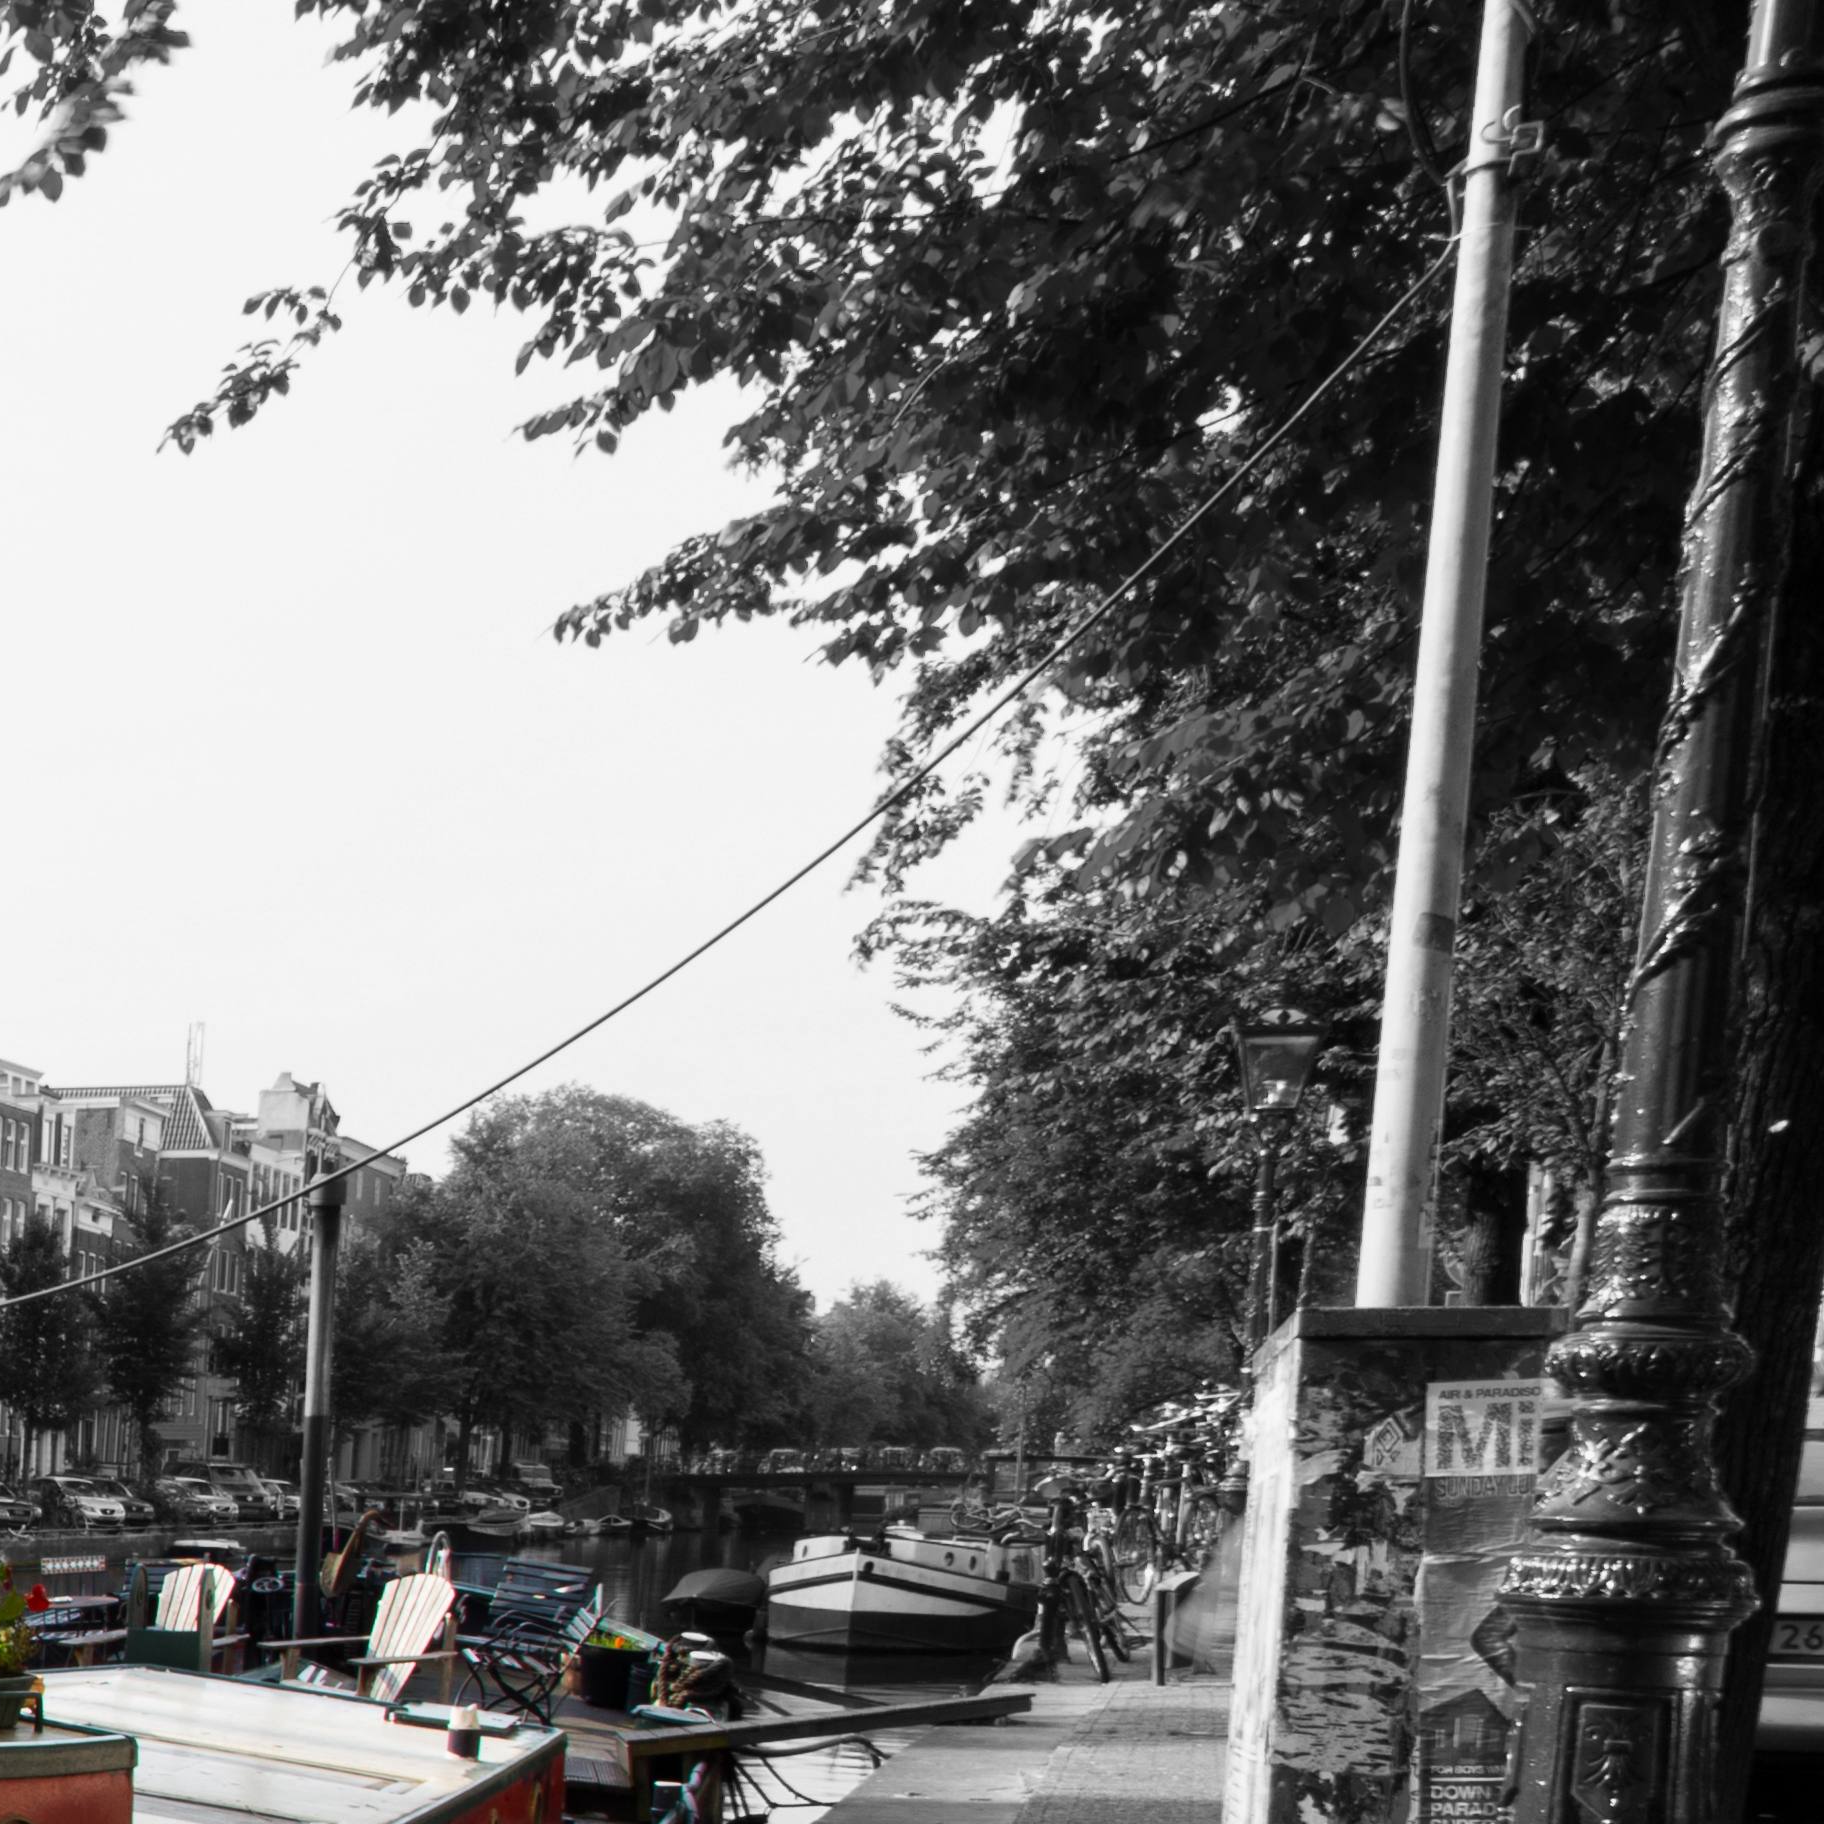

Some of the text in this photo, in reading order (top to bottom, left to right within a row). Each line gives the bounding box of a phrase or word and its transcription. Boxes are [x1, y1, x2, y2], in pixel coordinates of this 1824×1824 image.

[1475, 1386, 1542, 1399] PARADISO
[1430, 1785, 1491, 1800] DOWN
[1430, 1802, 1497, 1816] PARAD
